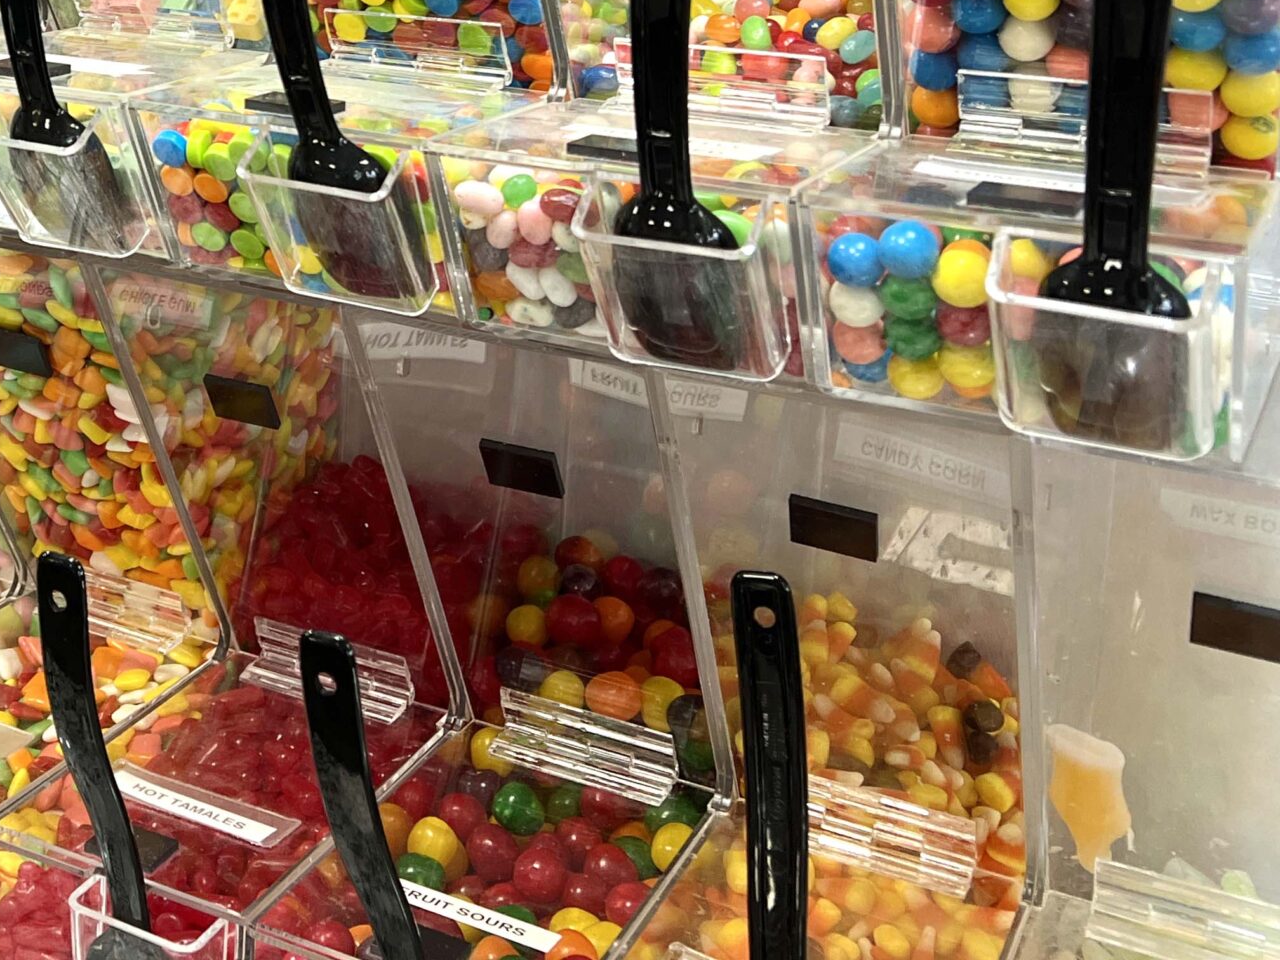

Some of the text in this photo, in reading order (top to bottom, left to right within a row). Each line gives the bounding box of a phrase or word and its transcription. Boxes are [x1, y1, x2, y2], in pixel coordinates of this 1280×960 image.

[132, 781, 247, 832] HOT TAMALES
[401, 884, 528, 938] FRUIT SOURS
